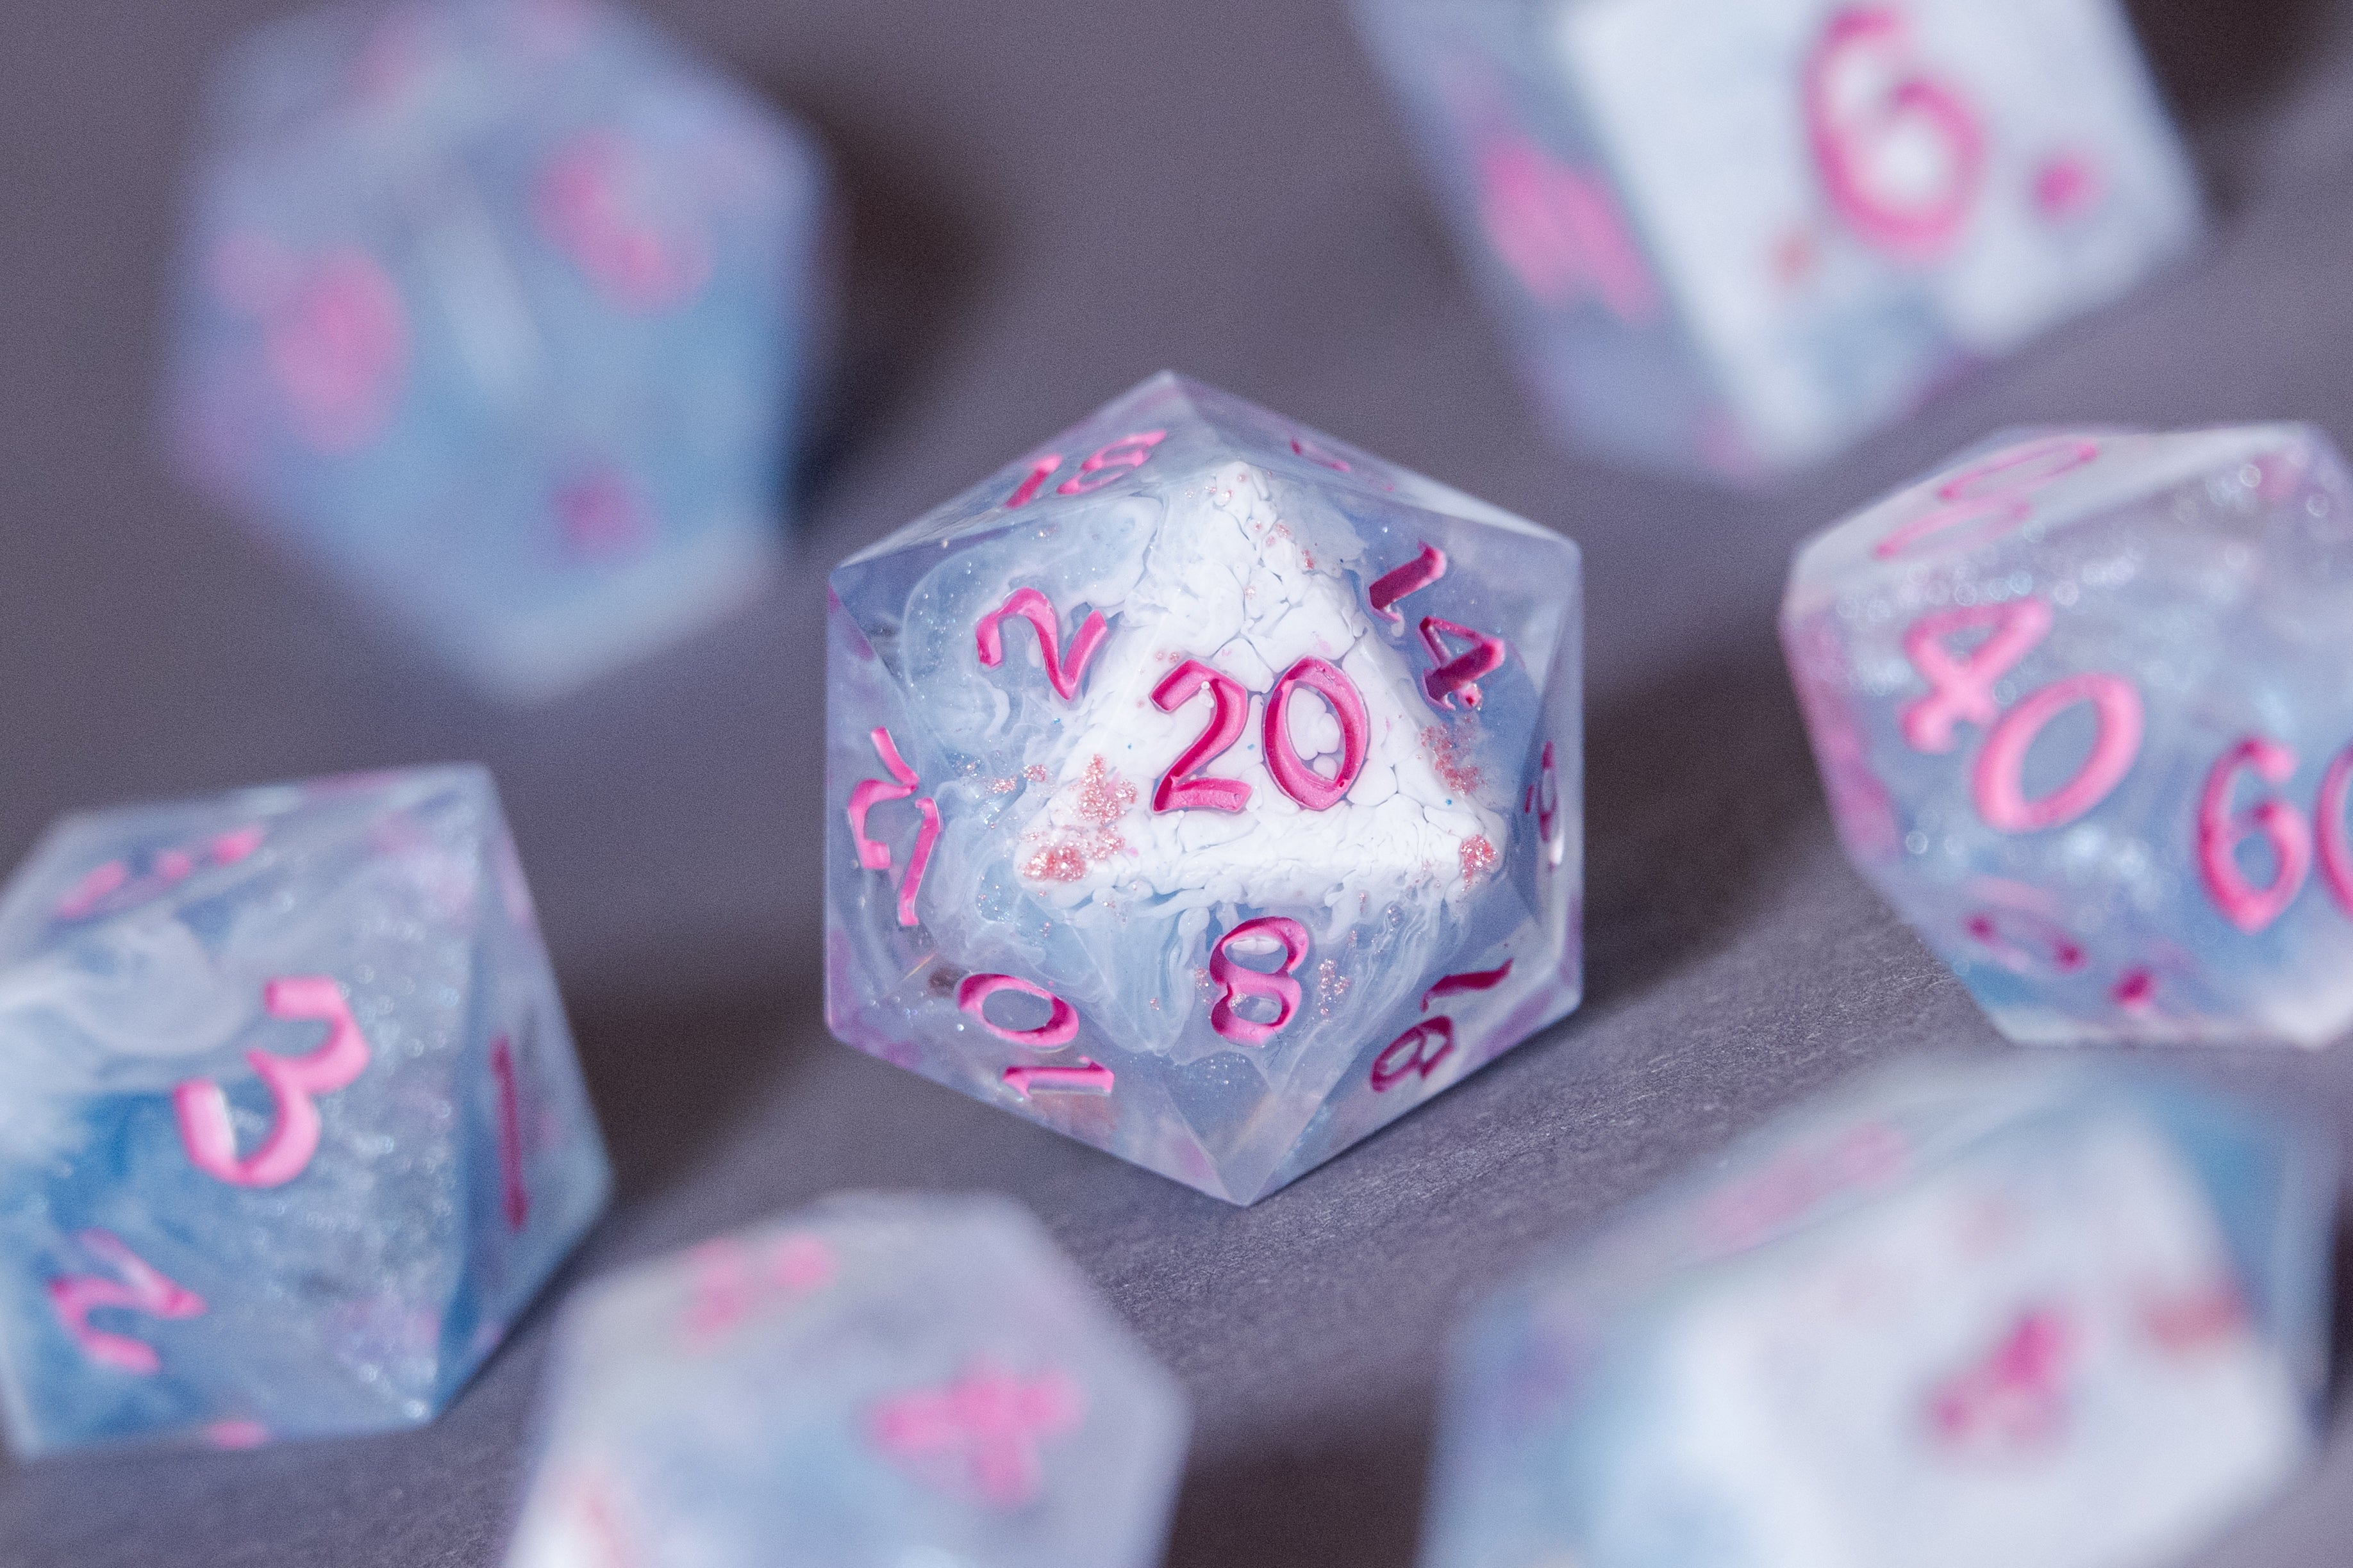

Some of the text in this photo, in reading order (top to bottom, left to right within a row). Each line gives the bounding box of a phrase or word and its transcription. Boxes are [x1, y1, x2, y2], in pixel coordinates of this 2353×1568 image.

[1004, 429, 1167, 509] 18
[975, 586, 1108, 701] 2
[1368, 541, 1505, 711] 14
[1150, 656, 1367, 813] 20
[1895, 596, 2142, 833] 40
[847, 726, 941, 926] 12
[957, 973, 1115, 1097] 10
[1208, 915, 1309, 1047] 8
[171, 975, 370, 1188] 3
